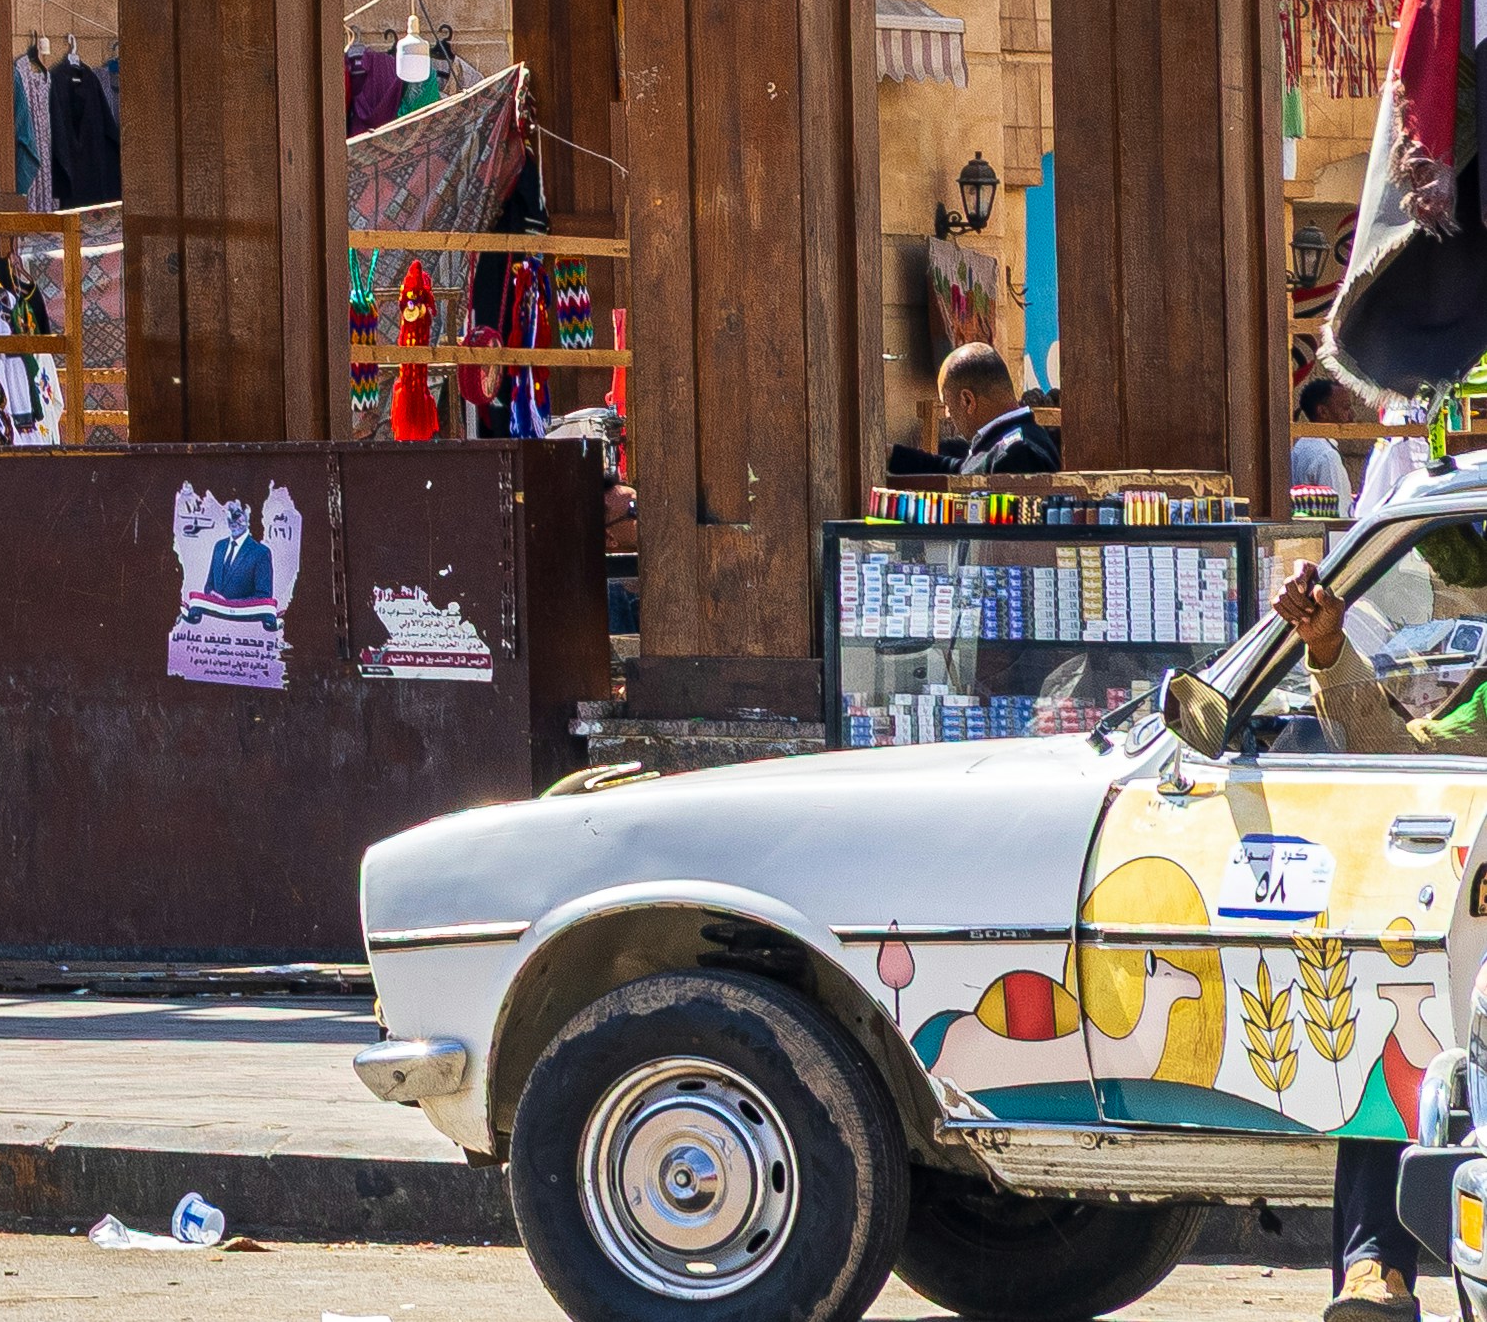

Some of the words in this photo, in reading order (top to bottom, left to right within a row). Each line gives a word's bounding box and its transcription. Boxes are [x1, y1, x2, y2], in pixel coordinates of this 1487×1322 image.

[172, 629, 202, 645] عباس
[235, 637, 264, 648] محمد
[1254, 871, 1286, 904] ٥٨
